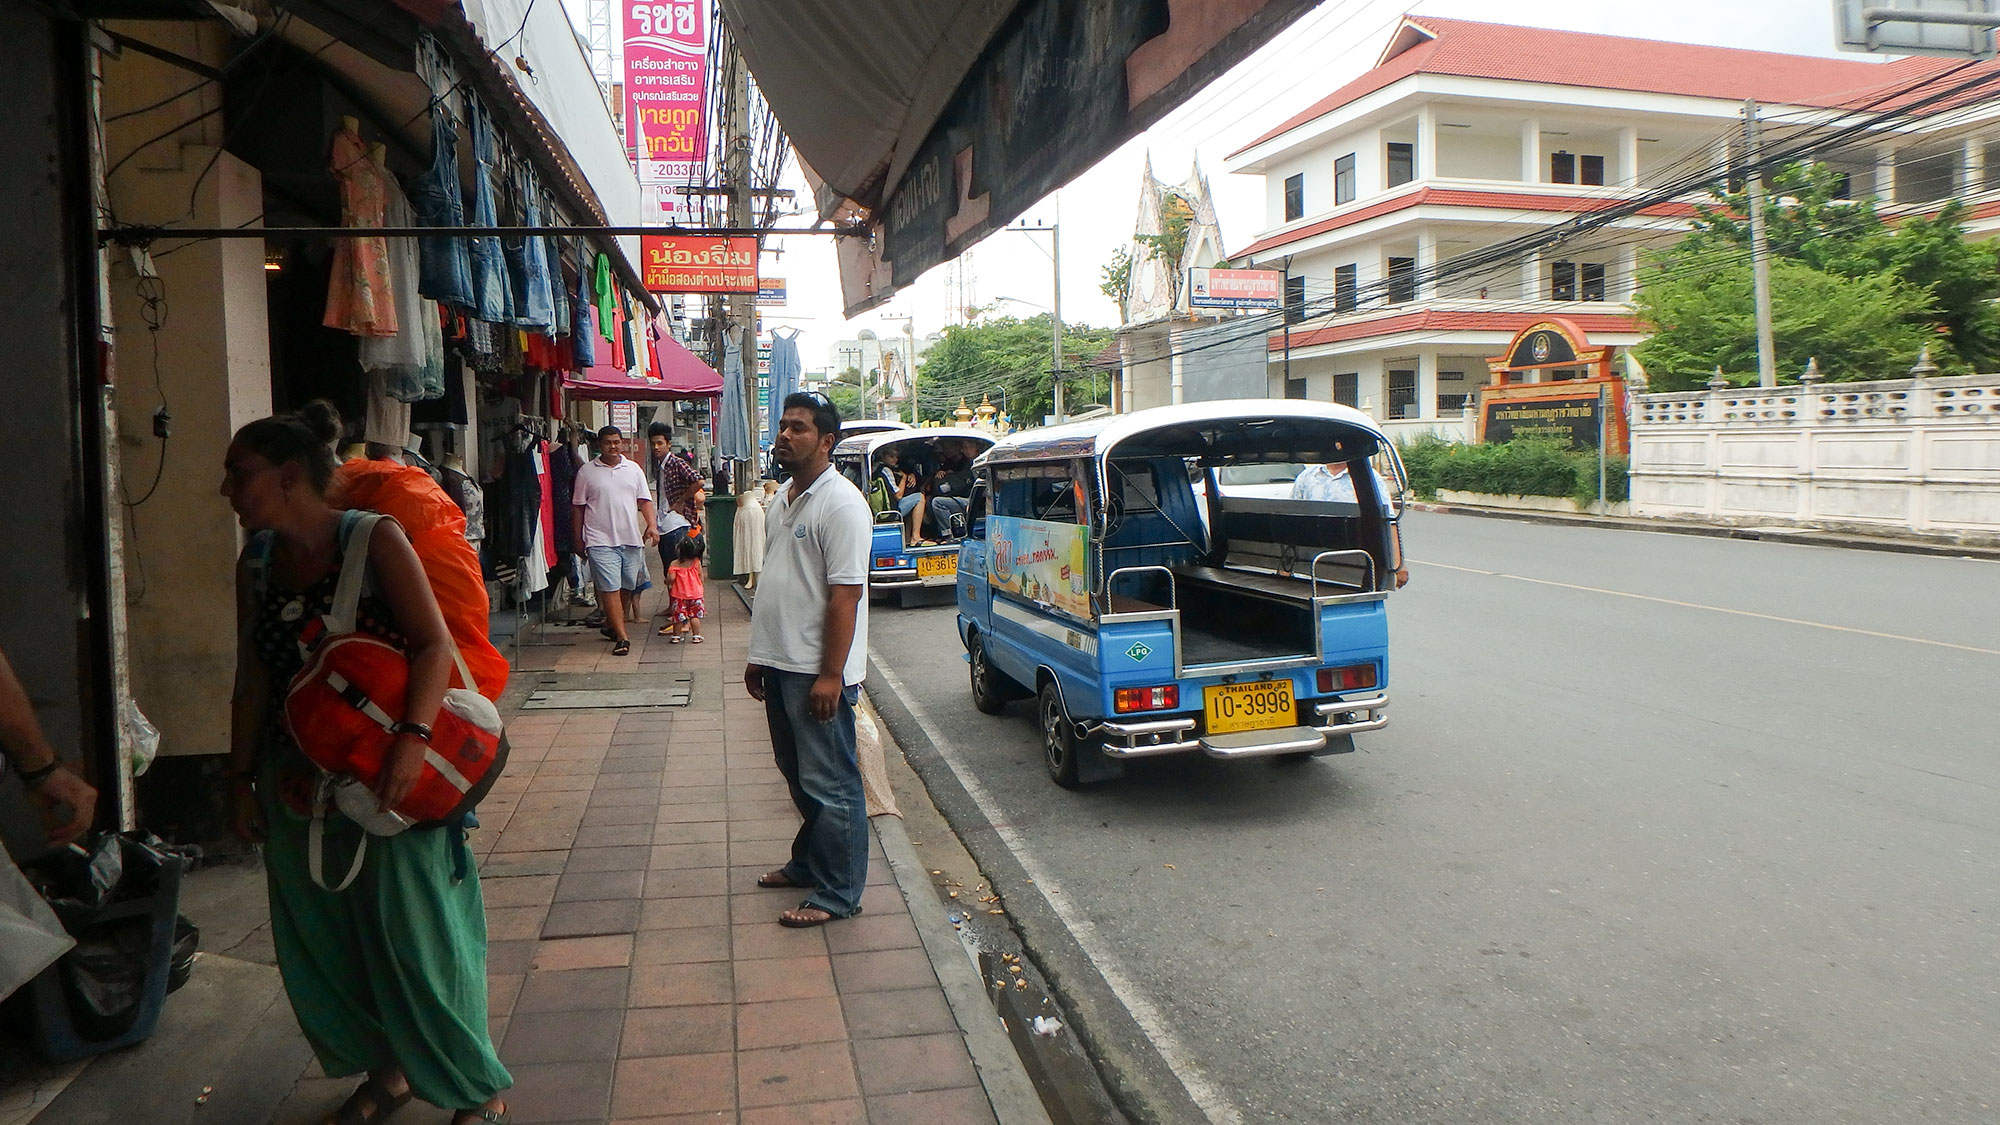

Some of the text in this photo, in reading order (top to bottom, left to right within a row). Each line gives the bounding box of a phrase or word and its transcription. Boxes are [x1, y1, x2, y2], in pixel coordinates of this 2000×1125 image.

[631, 56, 698, 71] เครื่องสำอาง
[635, 74, 695, 86] อาหารเสริม
[632, 91, 699, 103] อุปกรณ์เสริมสวย
[647, 268, 755, 287] ผ้ามือสองต่างประเทศ
[1130, 647, 1148, 656] LPG
[1225, 683, 1273, 693] THAILAND
[1214, 690, 1290, 719] 10-3998
